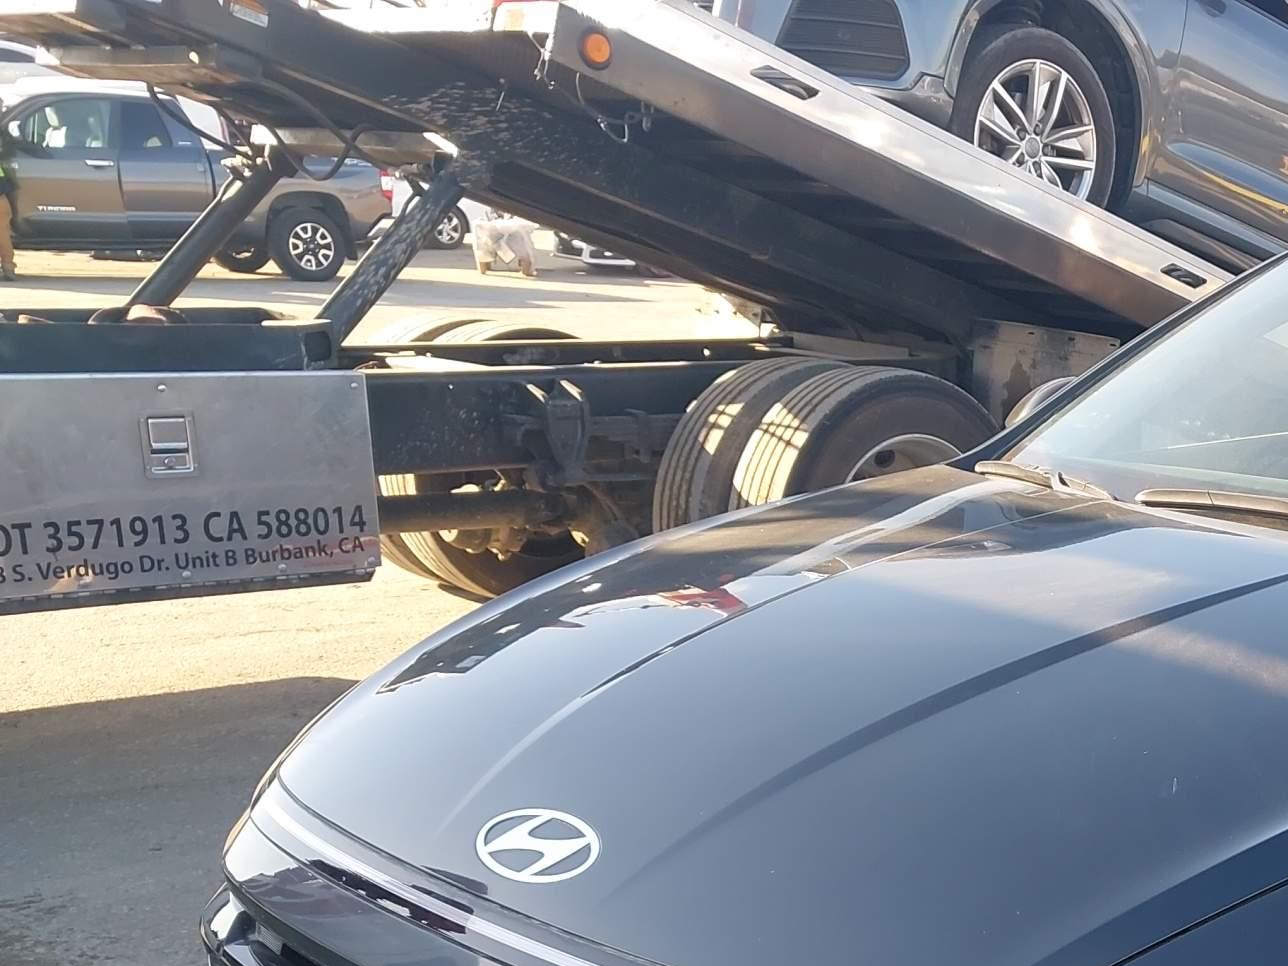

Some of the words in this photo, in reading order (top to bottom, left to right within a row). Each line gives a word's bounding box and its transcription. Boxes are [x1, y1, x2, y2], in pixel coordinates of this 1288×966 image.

[43, 513, 190, 554] 3571913
[203, 510, 249, 543] CA
[256, 504, 367, 541] 588014
[12, 563, 33, 583] S.
[36, 558, 134, 581] Verdugo
[138, 554, 170, 573] Dr.
[174, 550, 219, 570] Unit
[225, 550, 238, 567] B
[244, 539, 334, 565] Burbank,
[338, 535, 365, 554] CA
